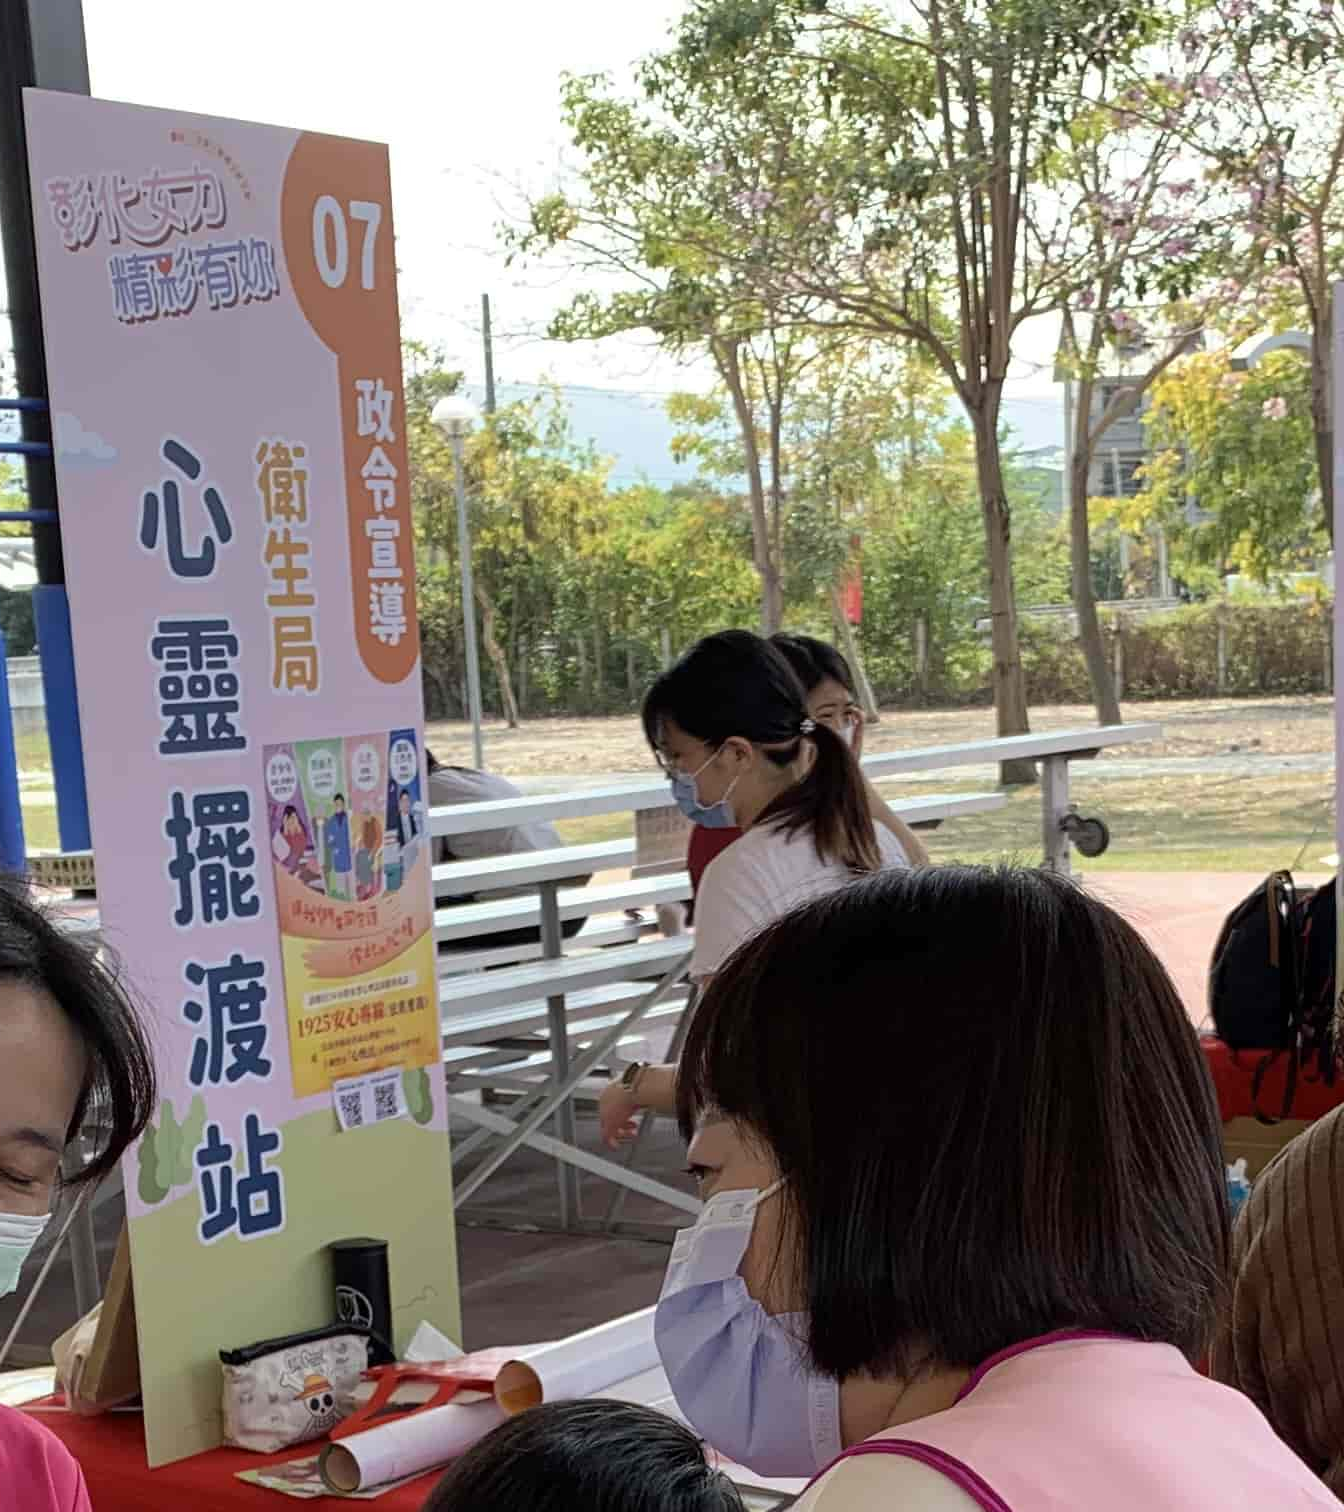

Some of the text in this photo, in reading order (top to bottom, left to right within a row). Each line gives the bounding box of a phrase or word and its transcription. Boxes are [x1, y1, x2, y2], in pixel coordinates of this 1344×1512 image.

[47, 170, 227, 252] 彰化女力
[109, 239, 281, 325] 精彩有妳
[312, 194, 382, 290] 07
[256, 440, 320, 692] 衛生局
[355, 377, 408, 648] 政令宣導
[140, 437, 286, 1243] 心靈擺渡站
